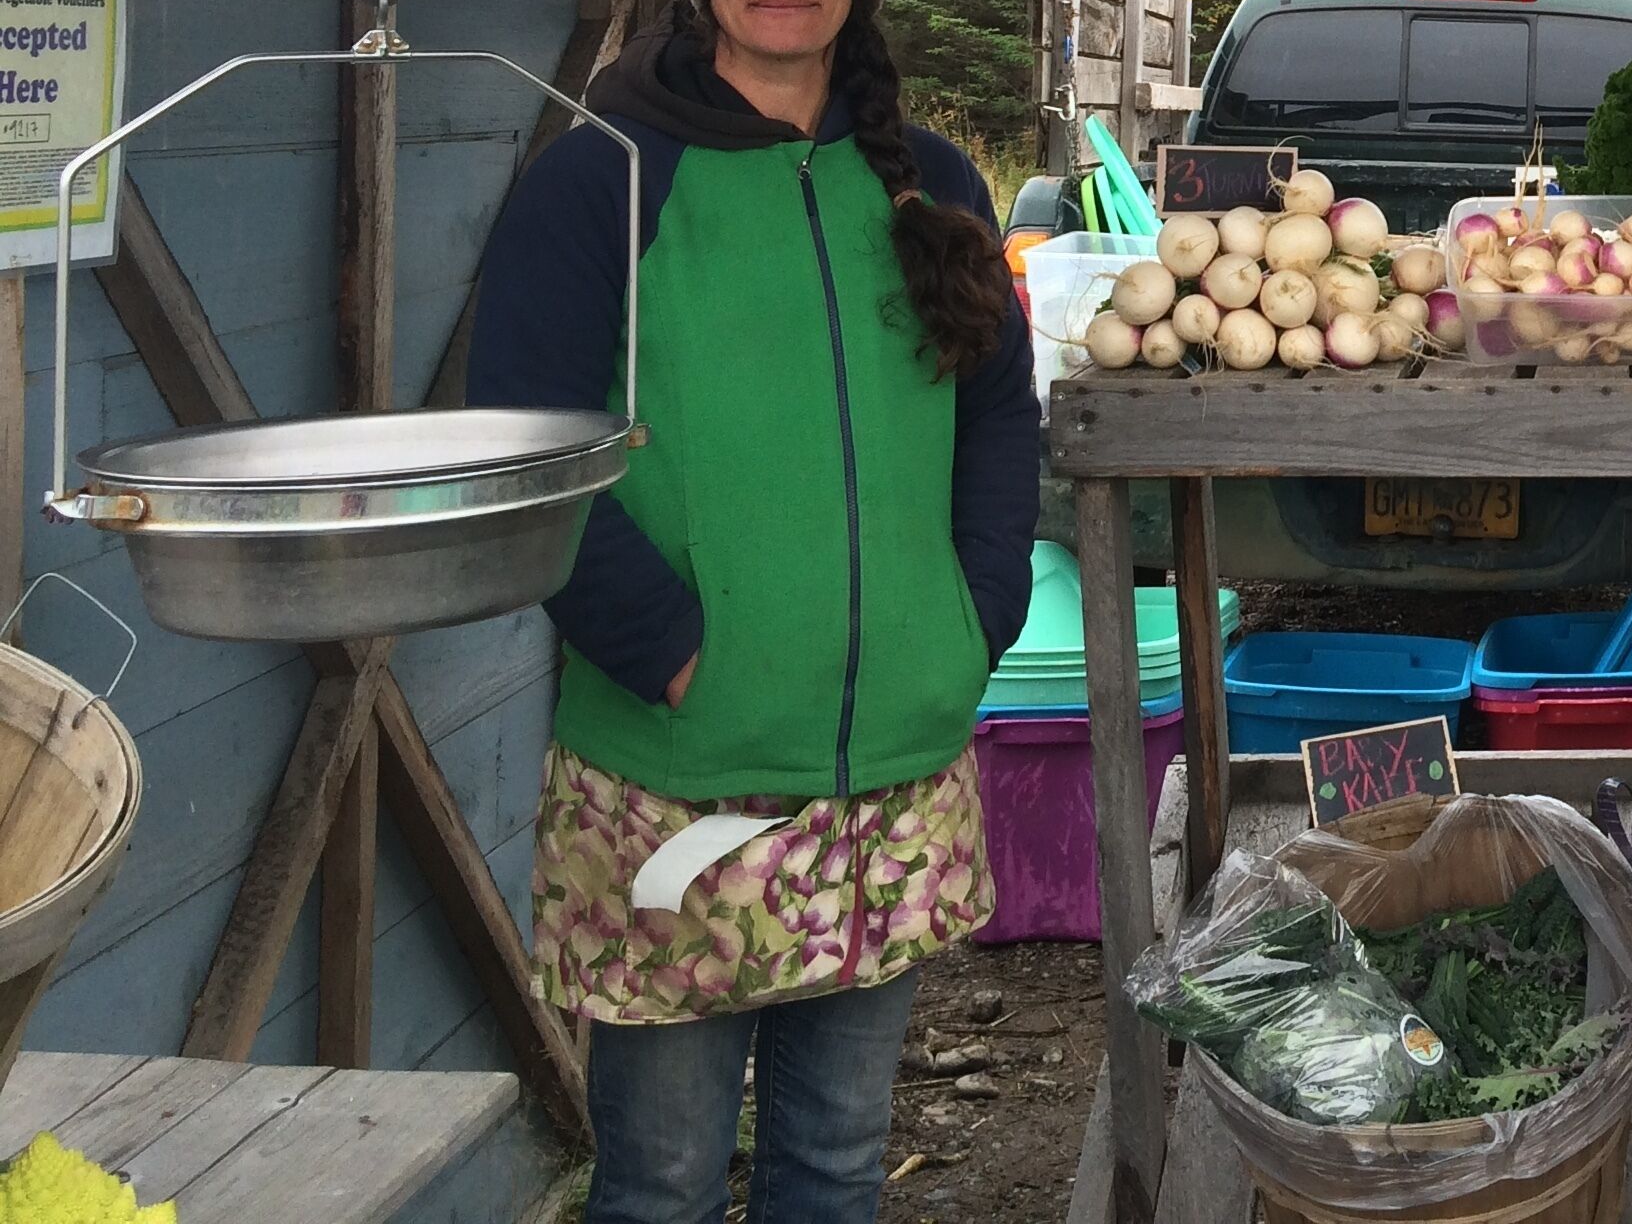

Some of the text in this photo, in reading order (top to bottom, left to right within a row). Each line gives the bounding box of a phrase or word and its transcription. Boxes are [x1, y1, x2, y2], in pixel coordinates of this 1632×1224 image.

[0, 20, 87, 57] cepted
[0, 70, 58, 104] Here
[1456, 480, 1513, 519] 873
